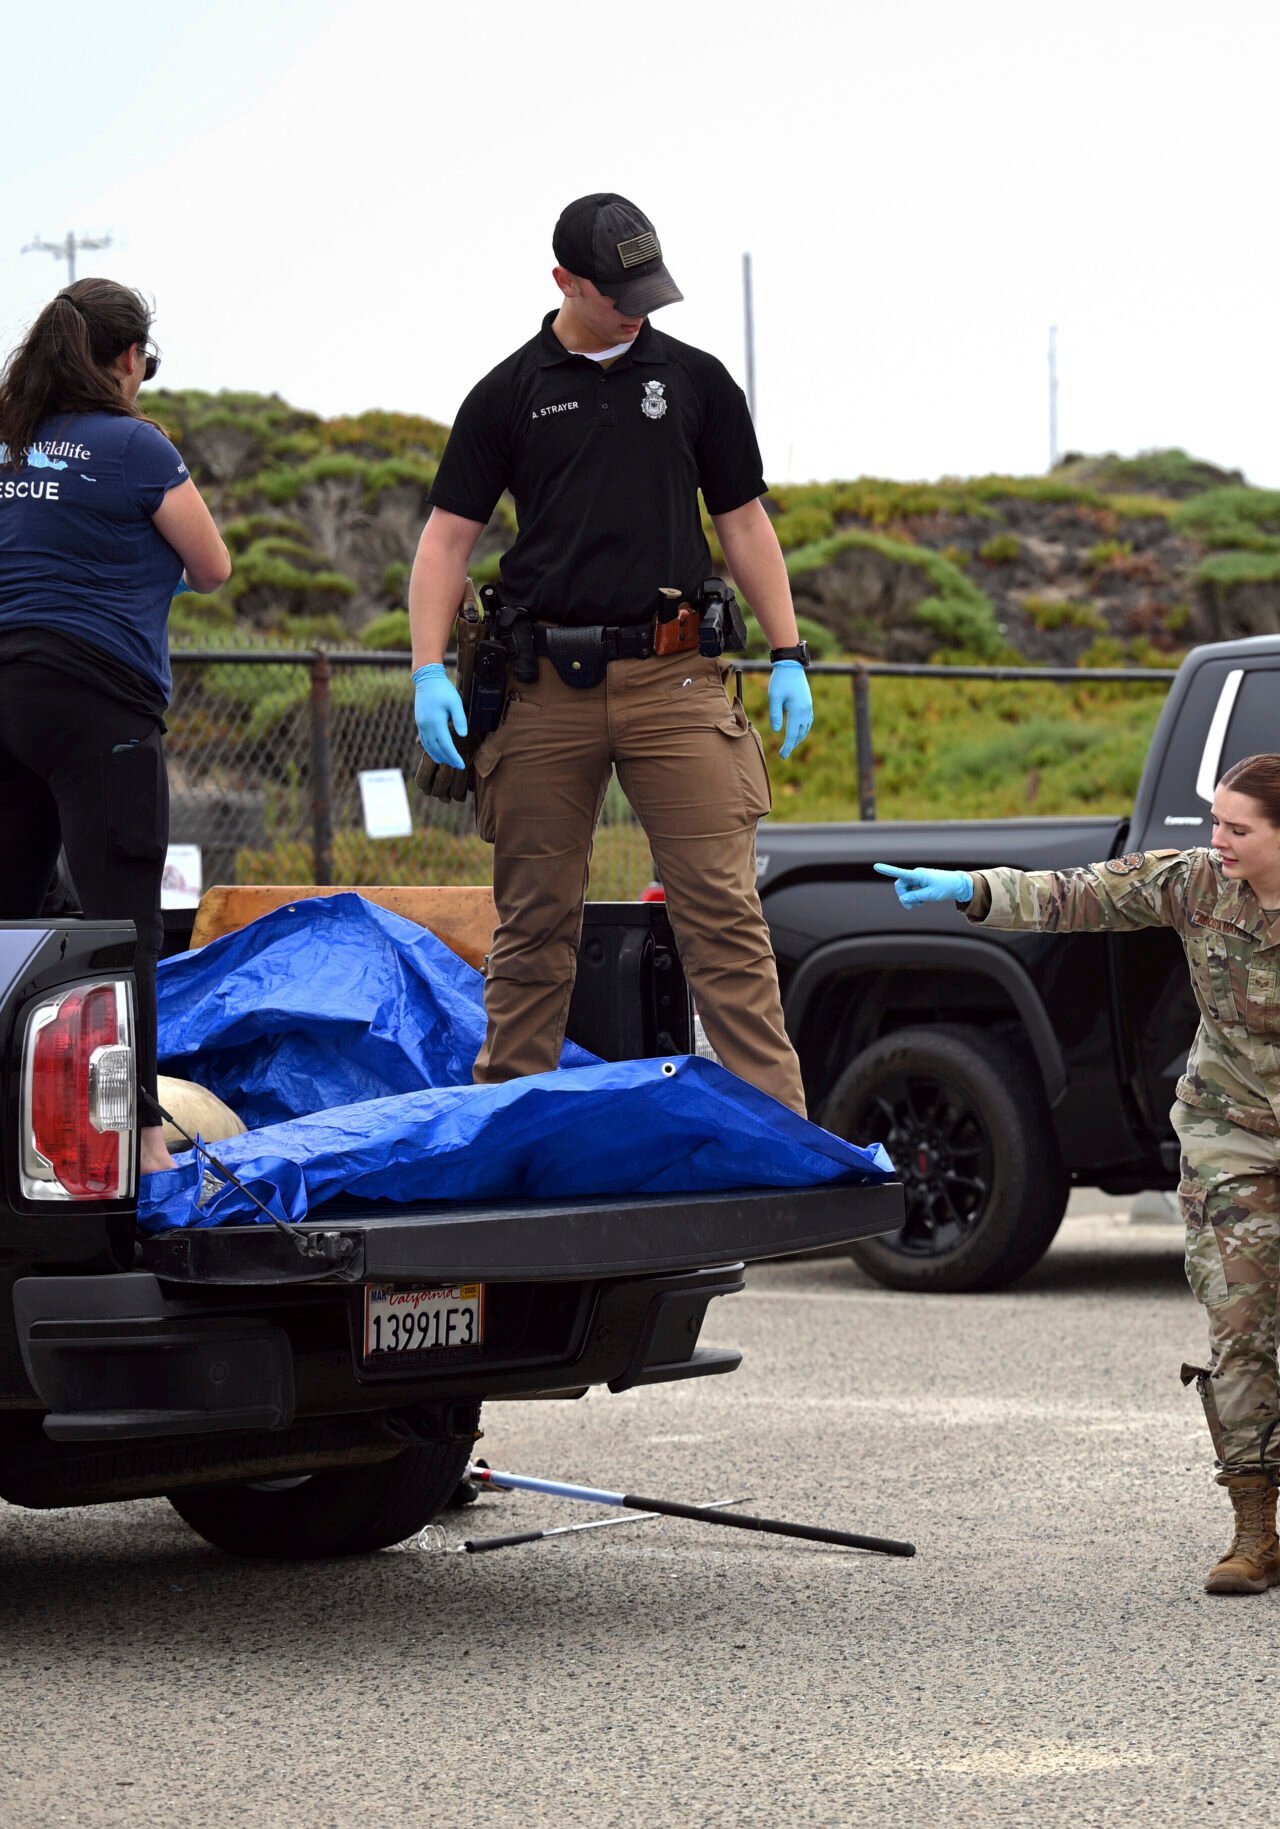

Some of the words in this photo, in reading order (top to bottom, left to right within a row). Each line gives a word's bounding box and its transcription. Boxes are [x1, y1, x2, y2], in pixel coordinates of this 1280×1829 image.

[540, 401, 579, 417] STRAYER
[33, 441, 91, 460] Wildlife
[0, 481, 59, 500] SCUE
[371, 1307, 474, 1354] 13991F3
